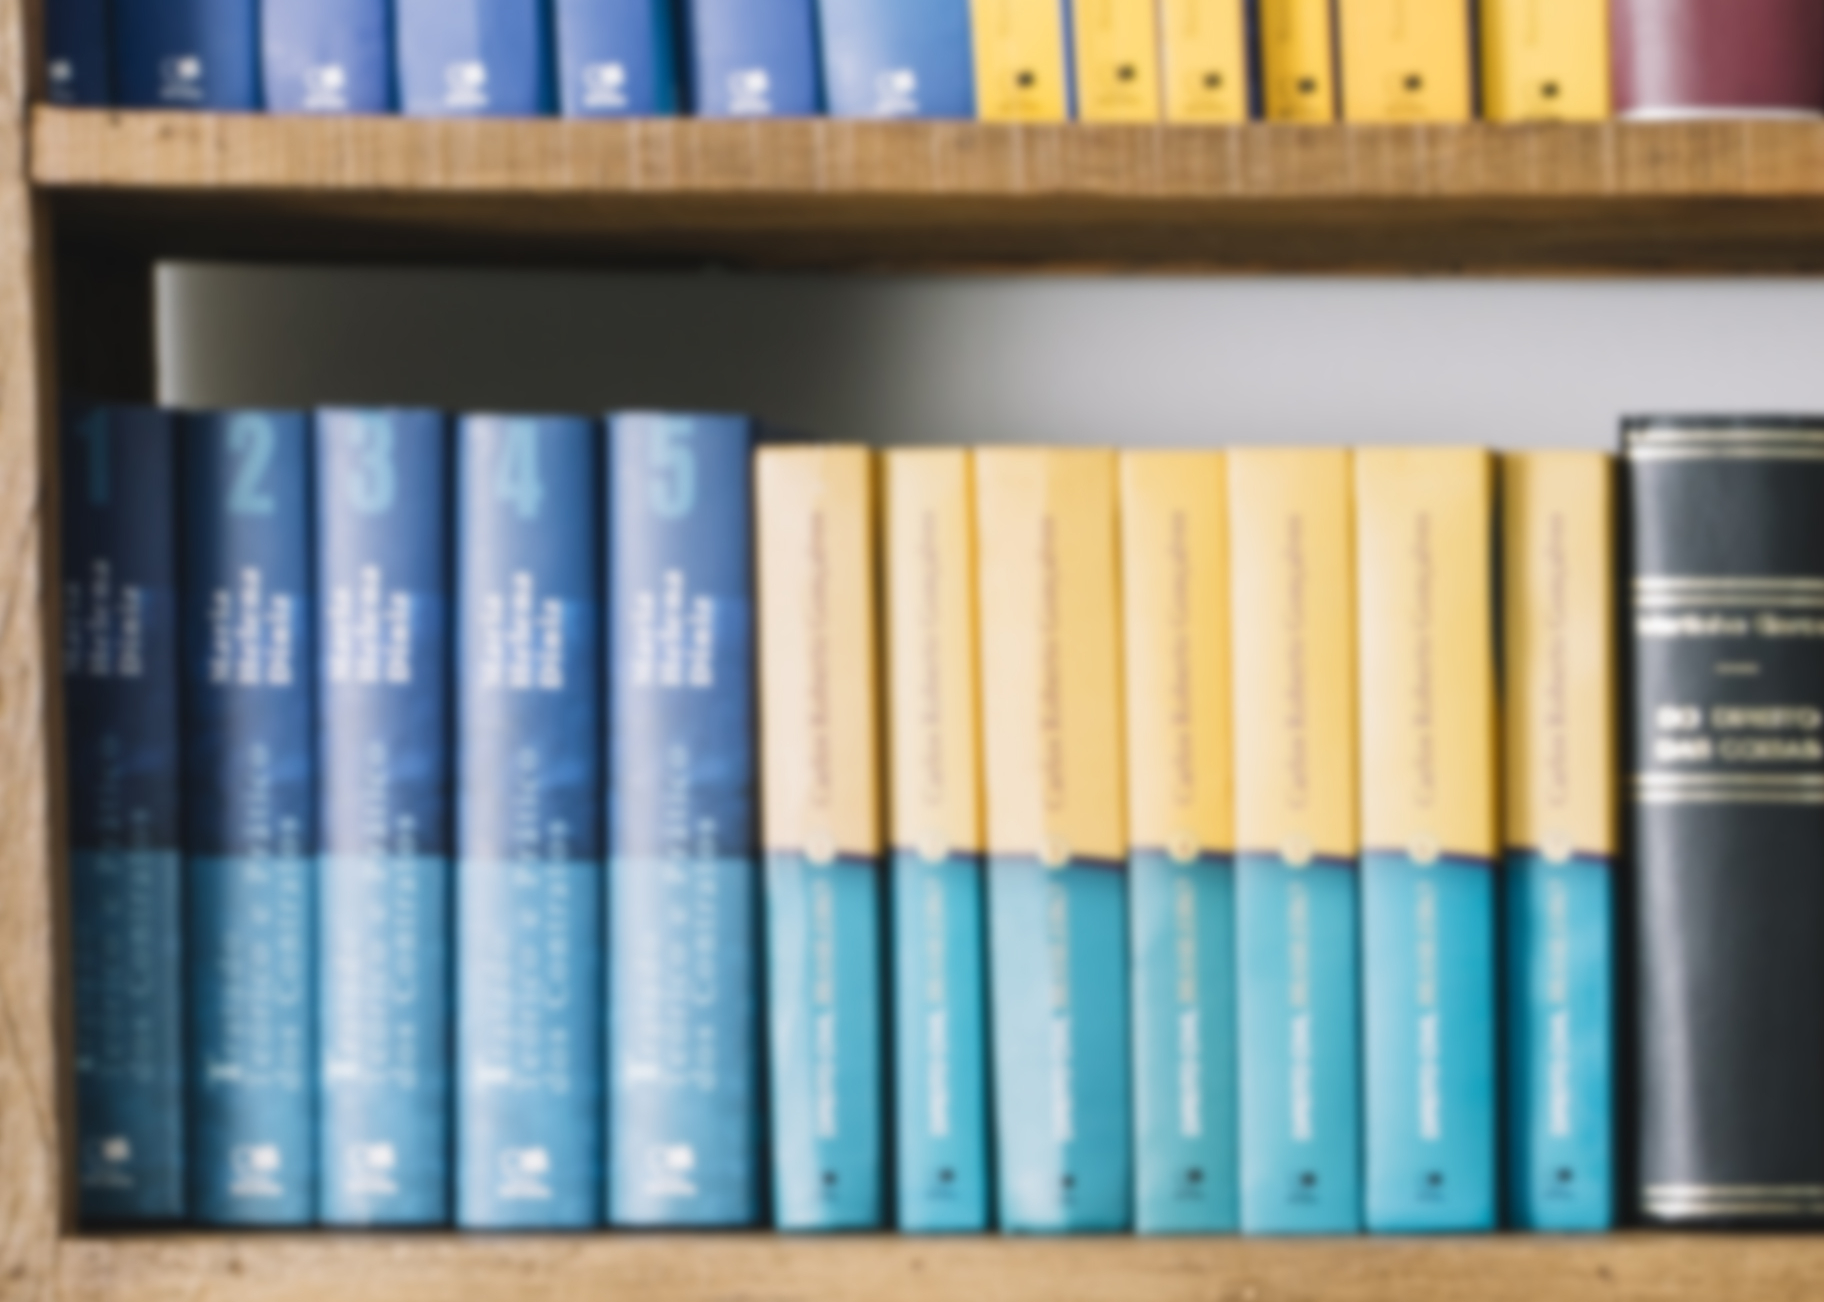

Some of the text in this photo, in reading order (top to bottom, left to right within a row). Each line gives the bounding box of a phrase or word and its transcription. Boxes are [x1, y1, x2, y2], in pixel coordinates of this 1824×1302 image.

[228, 412, 276, 514] 2
[345, 410, 397, 514] 3
[495, 420, 543, 518] 4
[648, 417, 696, 520] 5
